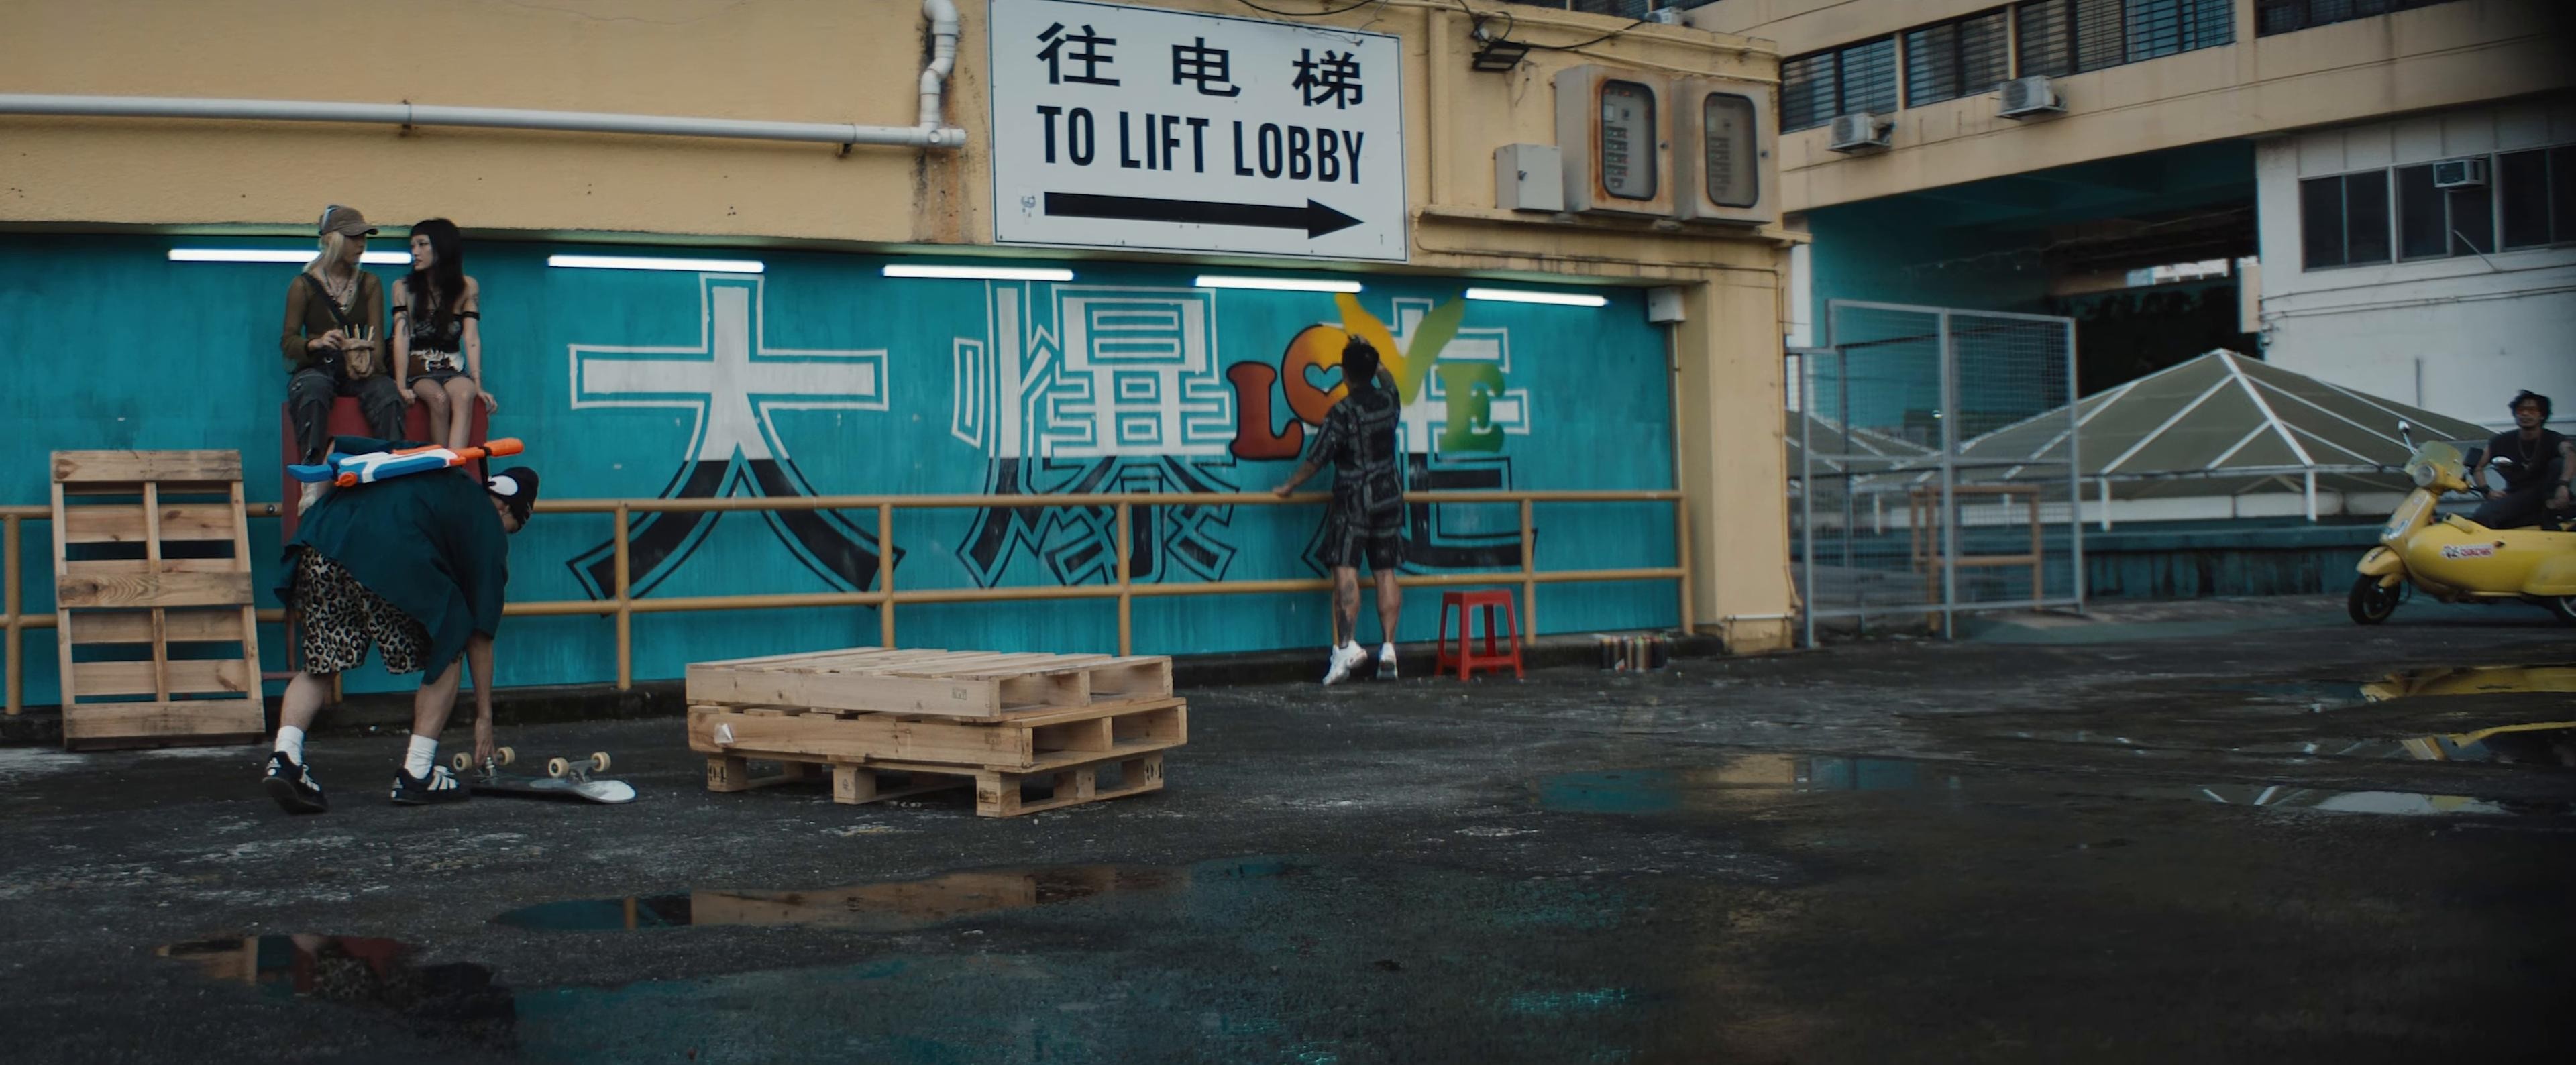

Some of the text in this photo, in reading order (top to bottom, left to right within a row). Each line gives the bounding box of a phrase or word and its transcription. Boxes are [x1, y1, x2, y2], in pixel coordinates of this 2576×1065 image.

[1036, 21, 1364, 109] 往电梯
[1037, 105, 1364, 184] TO LIFT LOBBY
[1226, 287, 1505, 460] LOVE
